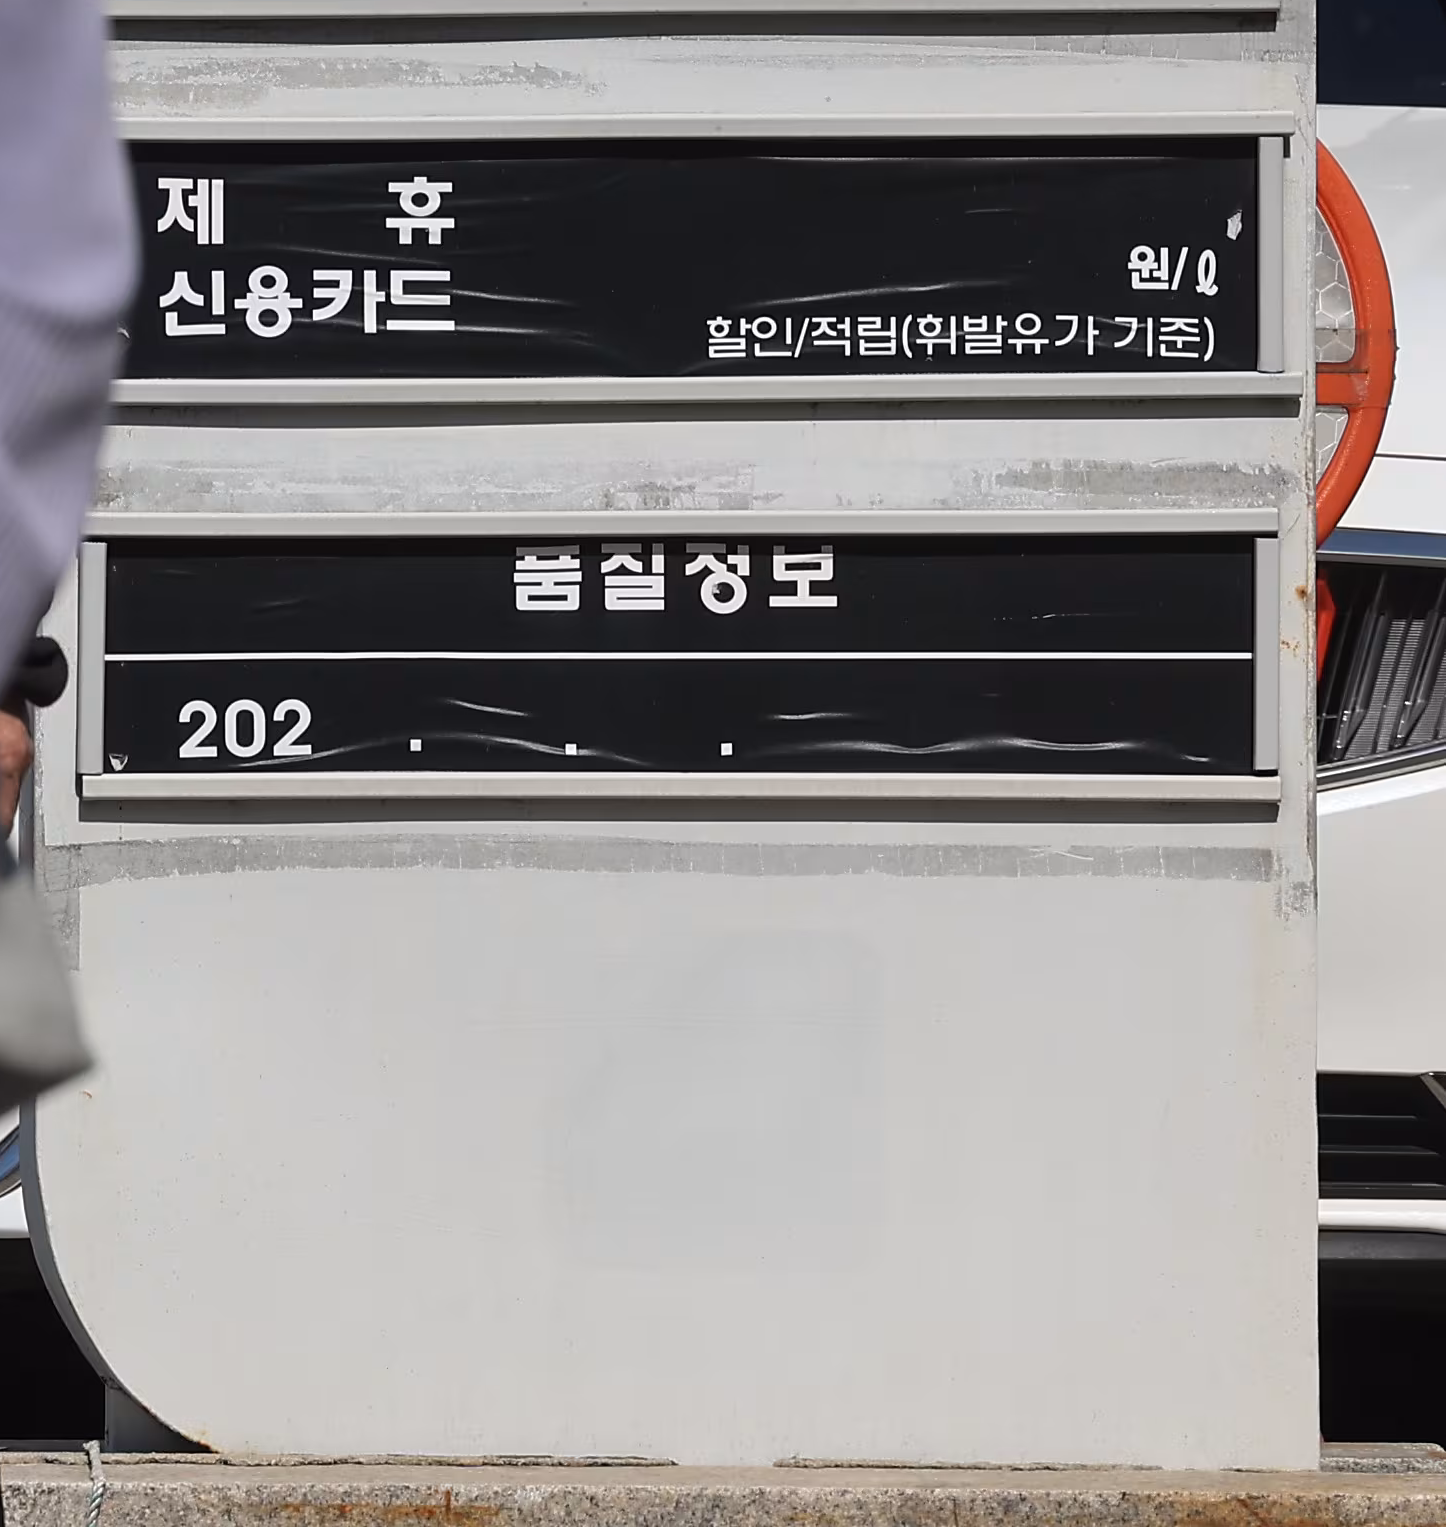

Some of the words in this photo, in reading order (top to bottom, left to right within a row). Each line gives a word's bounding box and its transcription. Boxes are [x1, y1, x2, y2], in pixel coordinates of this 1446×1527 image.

[158, 265, 456, 338] 신용카드
[706, 313, 1100, 359] 할인/적립(휘발유가
[1113, 316, 1215, 362] 기준)
[513, 543, 839, 615] 품질정보
[178, 698, 312, 759] 202
